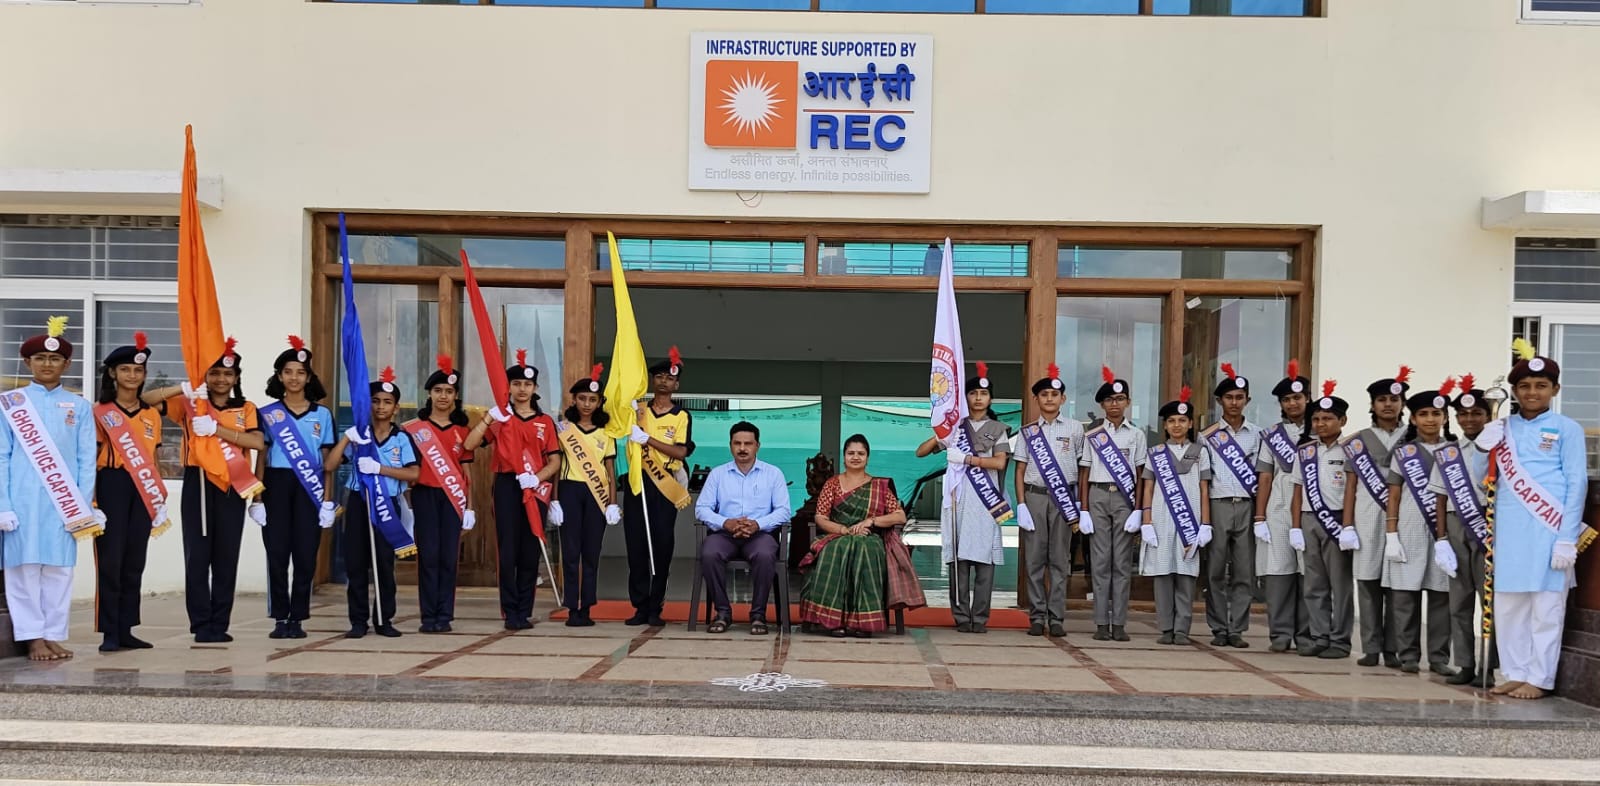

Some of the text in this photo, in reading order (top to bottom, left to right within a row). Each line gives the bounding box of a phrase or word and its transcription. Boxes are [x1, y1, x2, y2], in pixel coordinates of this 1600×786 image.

[706, 39, 917, 57] INFRASTRUCTURE SUPPORTED BY
[810, 114, 906, 152] REC
[705, 167, 913, 183] Endless energy. Infinite possibilities.
[730, 152, 773, 167] असीमित
[11, 408, 82, 519] GHOSH VICE CAPTAIN
[119, 431, 145, 468] VICE
[279, 426, 325, 502] VICE CAPTA
[426, 445, 450, 475] VICE
[566, 434, 587, 460] VICE
[1222, 444, 1257, 484] SPORTS
[1269, 433, 1297, 464] SPORTS
[1495, 437, 1517, 480] HOSH
[970, 467, 1000, 507] CAPTAIN
[1031, 437, 1053, 469] SCHOOL
[1045, 467, 1063, 488] VICE
[1054, 486, 1079, 520] CAPTAIN
[1101, 445, 1135, 493] DISCIPLINE
[1153, 453, 1179, 495] DISCIPLINE
[1169, 493, 1187, 513] VICE
[1355, 454, 1385, 494] CULTURE
[1403, 458, 1428, 488] CHILD
[1305, 463, 1343, 538] CULTURE CAPT
[1444, 463, 1488, 538] CHILD SAFETY VICE
